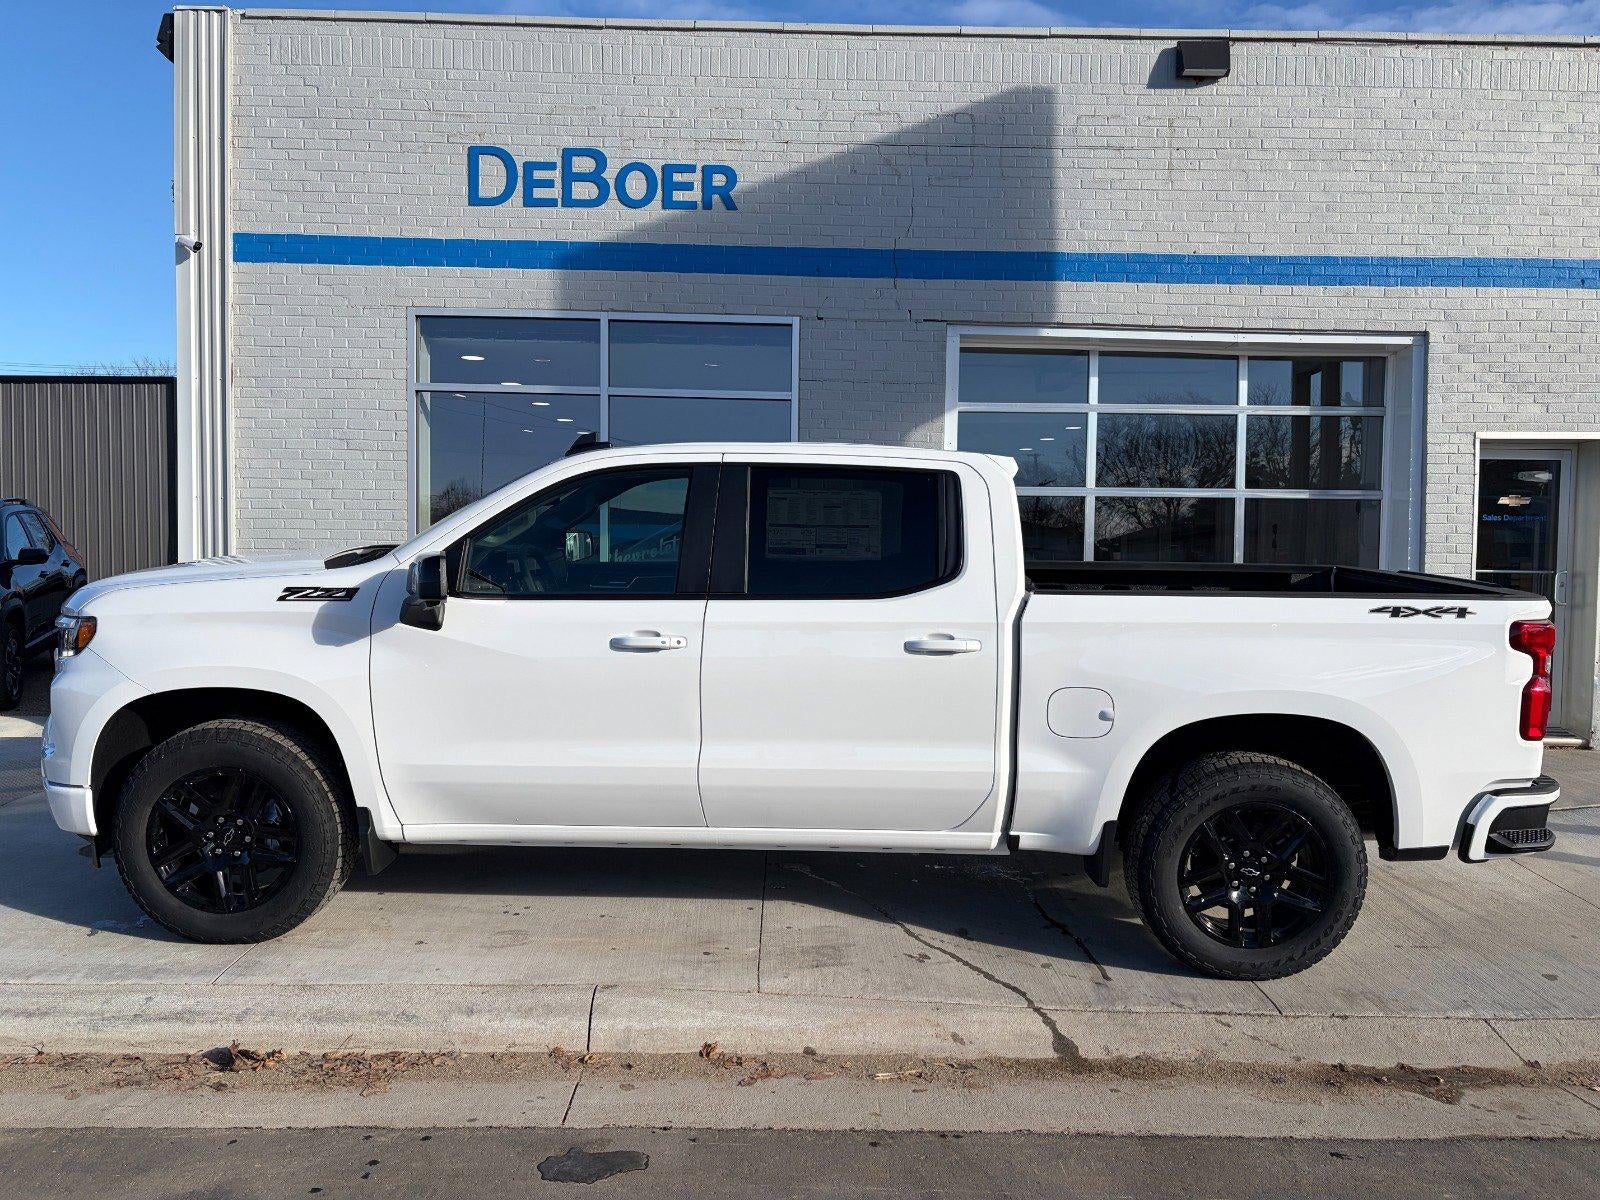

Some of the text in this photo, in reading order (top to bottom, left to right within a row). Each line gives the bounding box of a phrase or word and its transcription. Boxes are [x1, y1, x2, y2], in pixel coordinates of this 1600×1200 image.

[1482, 513, 1547, 522] Sales Department
[607, 535, 681, 562] hevrolet
[276, 586, 360, 601] Z71
